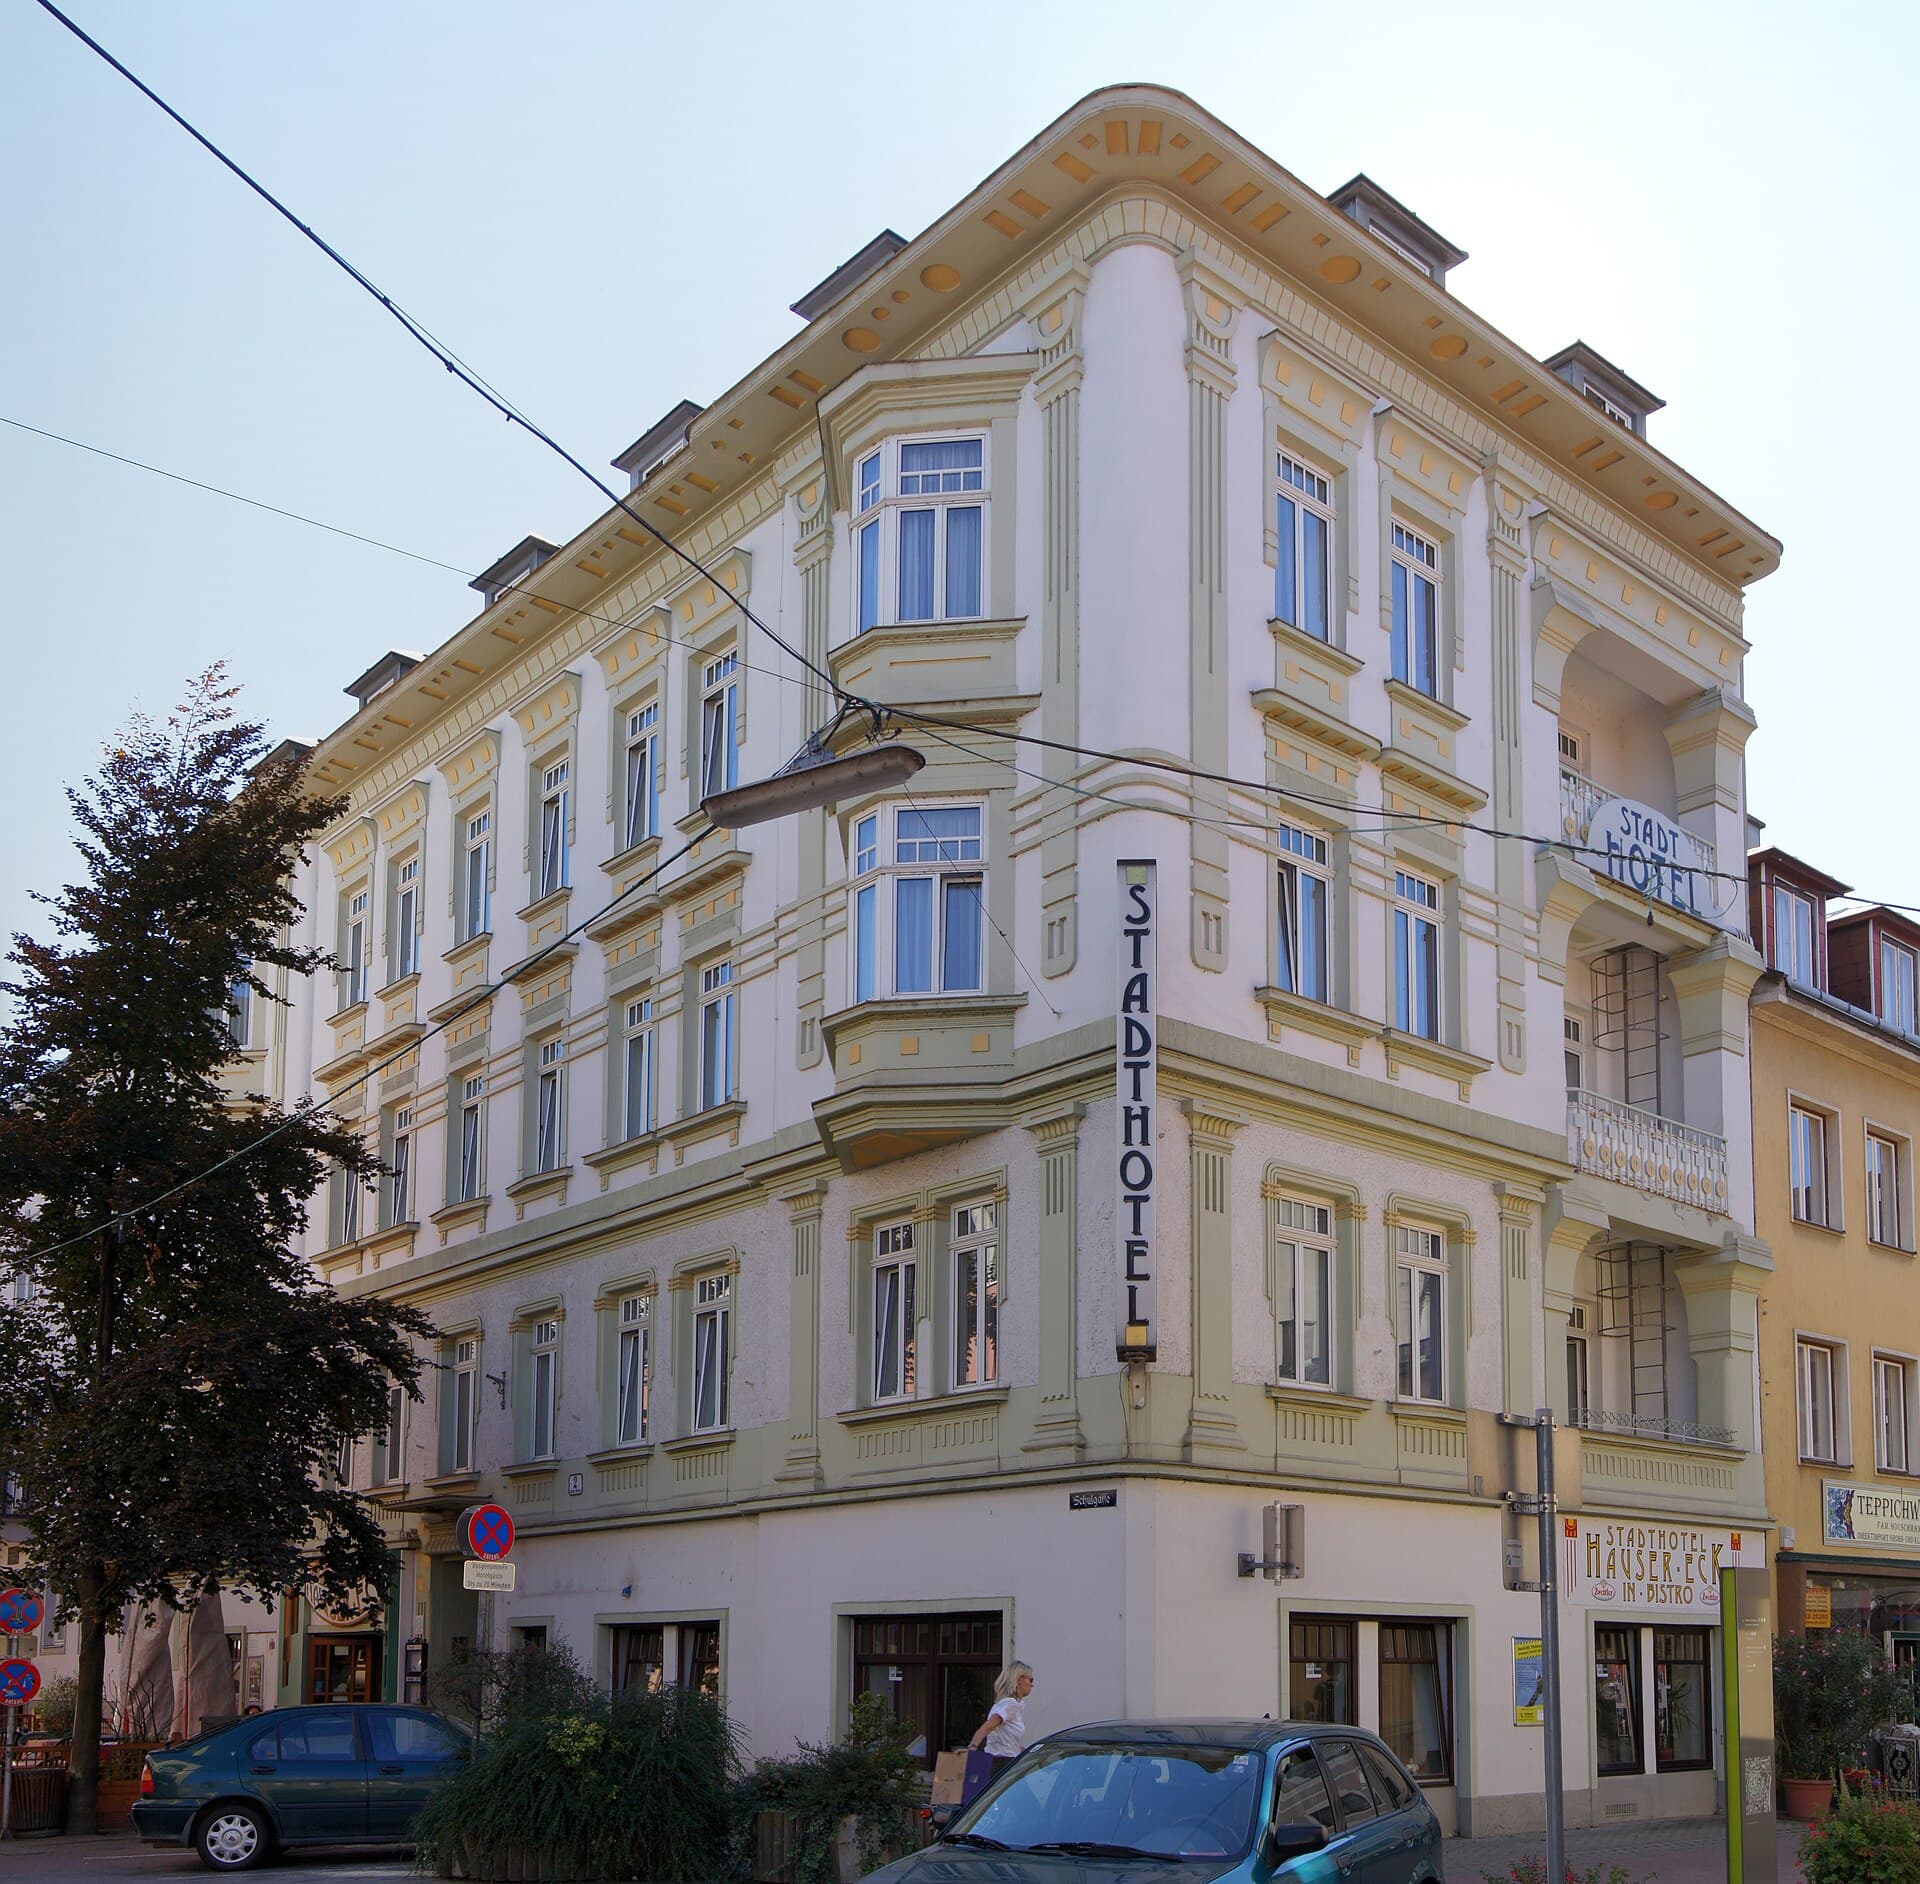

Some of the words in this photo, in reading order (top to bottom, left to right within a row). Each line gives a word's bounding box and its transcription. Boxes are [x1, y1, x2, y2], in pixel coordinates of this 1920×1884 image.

[1620, 806, 1678, 859] STADT
[1606, 830, 1702, 916] HOTEL
[1120, 885, 1153, 1326] STADTHOTEL
[1587, 1533, 1672, 1582] HAUSER
[1607, 1526, 1706, 1553] STADTHOTEL
[1623, 1582, 1636, 1602] IN
[1647, 1583, 1693, 1604] BISTRO
